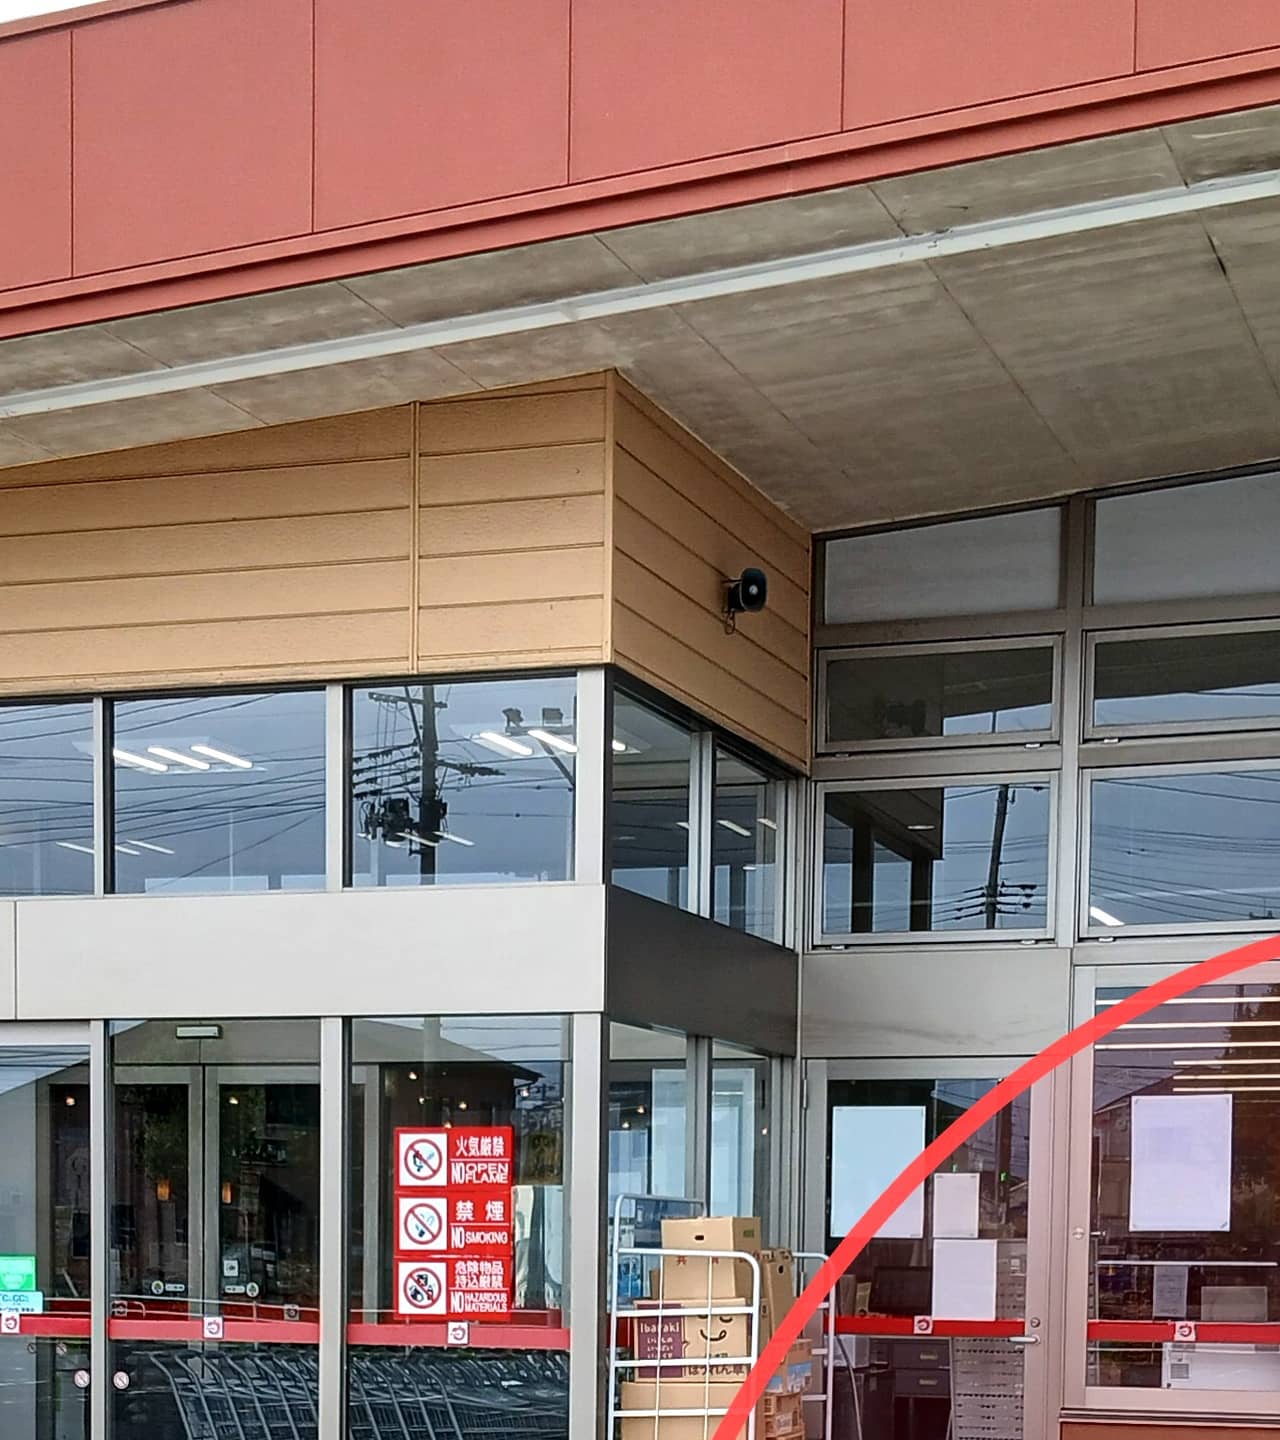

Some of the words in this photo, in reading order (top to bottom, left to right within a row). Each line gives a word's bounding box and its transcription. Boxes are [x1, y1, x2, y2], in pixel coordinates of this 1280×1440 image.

[456, 1136, 504, 1157] 火気厳禁
[451, 1162, 464, 1184] NO
[466, 1163, 508, 1173] OPEN
[466, 1173, 508, 1183] FLAME
[451, 1226, 465, 1249] NO
[466, 1231, 508, 1244] SMOKING
[451, 1291, 464, 1312] NO
[640, 1321, 679, 1333] Ibaaki
